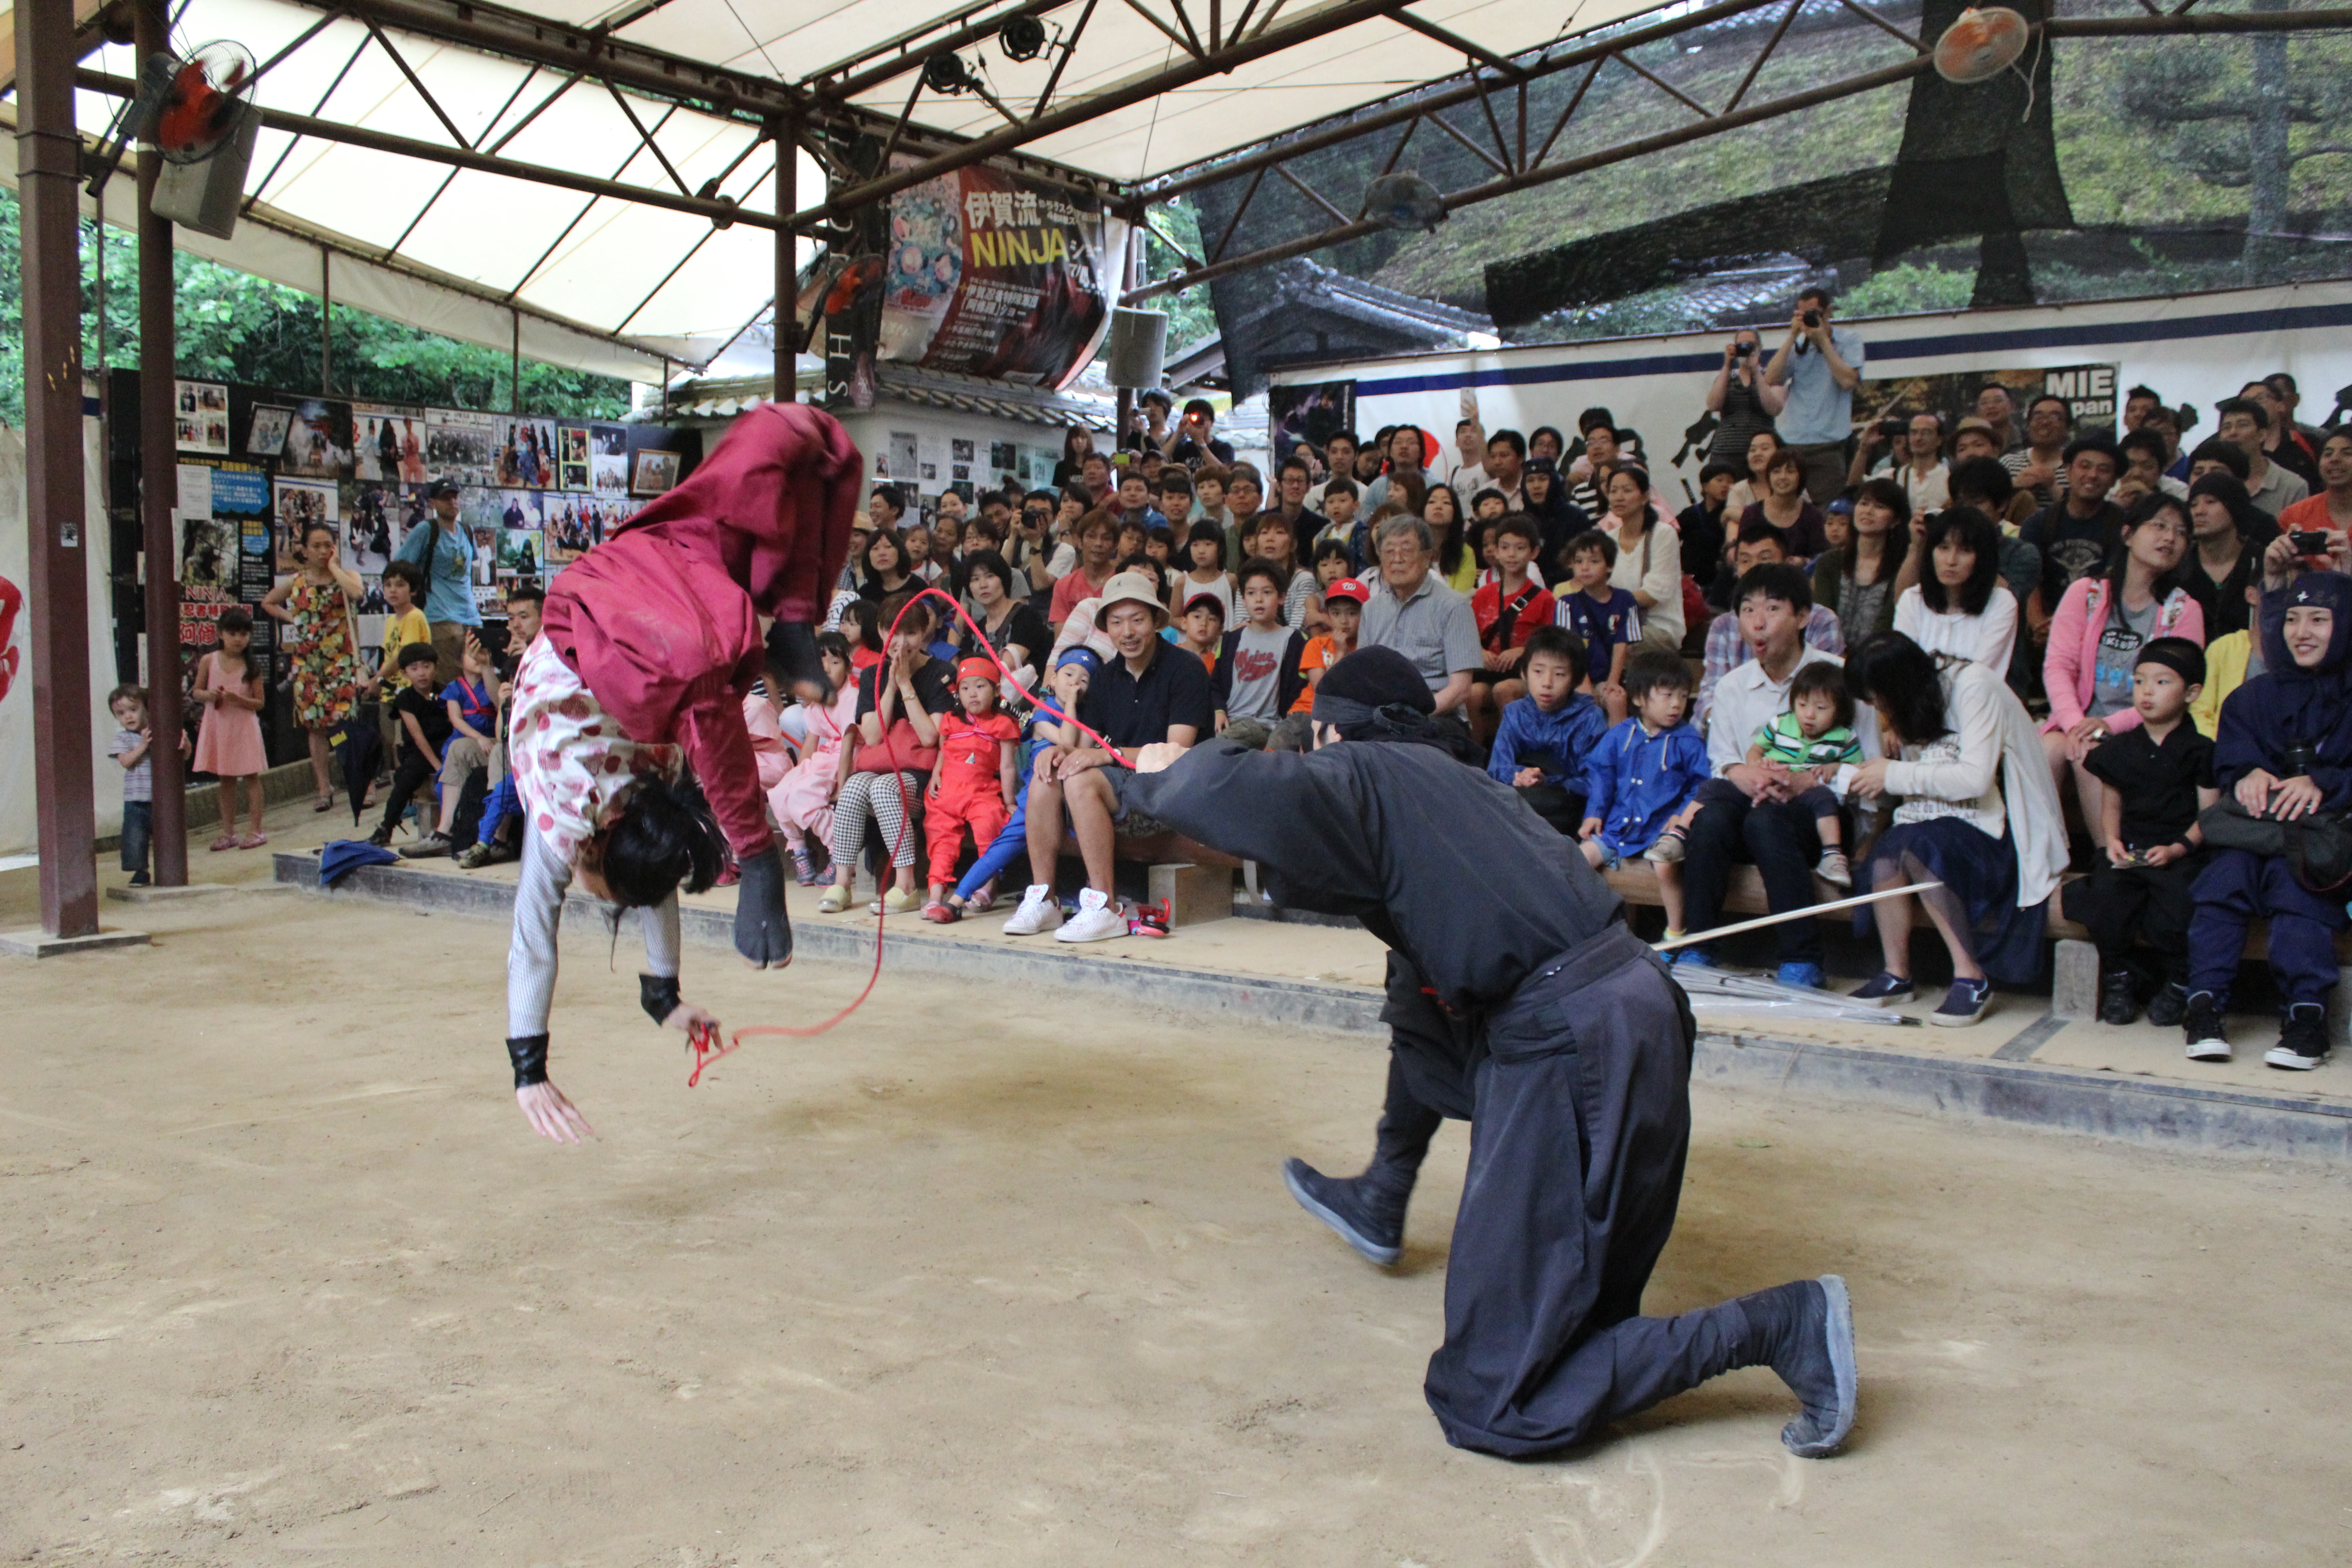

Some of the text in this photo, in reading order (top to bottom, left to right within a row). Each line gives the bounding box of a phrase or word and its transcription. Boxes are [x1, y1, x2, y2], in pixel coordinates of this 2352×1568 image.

[964, 190, 1041, 229] 伊賀流
[970, 228, 1070, 268] NINJA
[2045, 368, 2114, 398] MIE
[185, 585, 228, 602] NINJA
